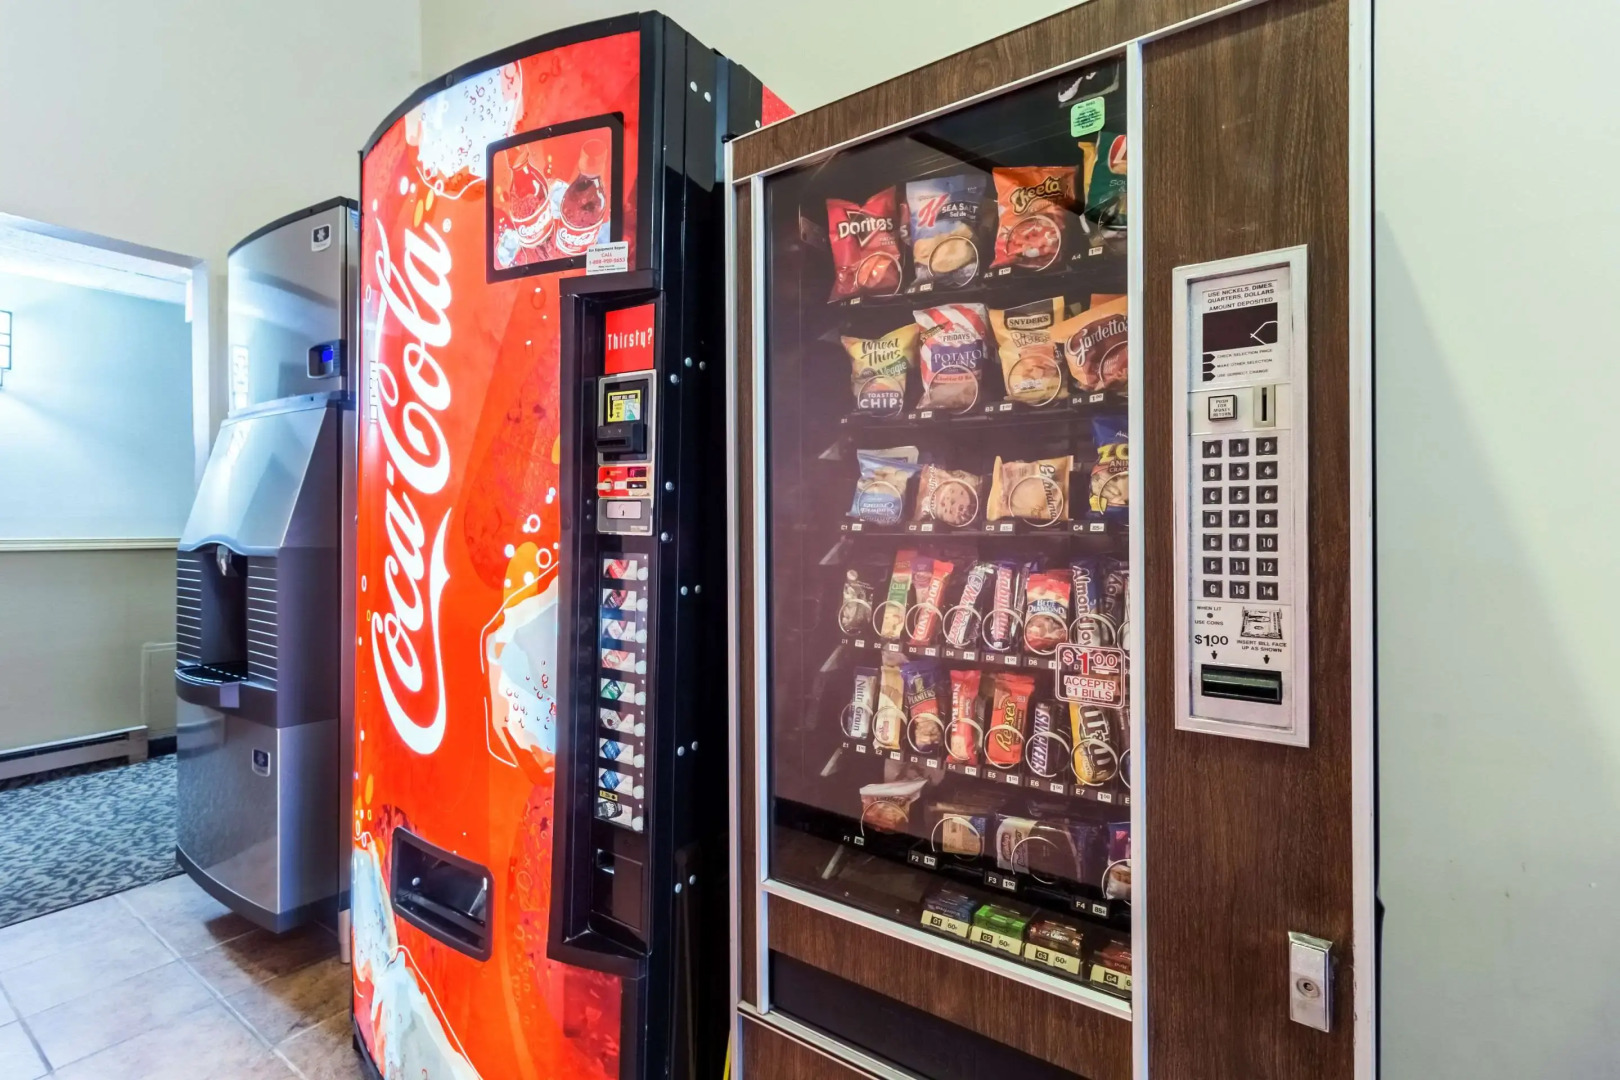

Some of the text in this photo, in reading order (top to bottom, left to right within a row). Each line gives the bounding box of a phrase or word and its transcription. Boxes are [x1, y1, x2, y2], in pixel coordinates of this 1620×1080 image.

[1010, 176, 1062, 215] Cheeto
[942, 203, 978, 214] SEA SALT
[838, 216, 894, 239] Doritos
[1244, 289, 1274, 298] DOLLARS
[1209, 297, 1273, 312] AMOUNT DEPOSITED
[608, 328, 653, 350] Thirsty?
[943, 332, 971, 342] FRIDAYS
[862, 338, 899, 353] Wheat
[861, 350, 901, 366] Thins
[934, 350, 982, 364] POTATO
[878, 362, 907, 377] Veggie
[1210, 445, 1215, 454] A
[1238, 444, 1241, 452] 1
[1264, 442, 1270, 451] 2
[1237, 467, 1242, 476] 3
[1264, 466, 1271, 475] 4
[371, 216, 453, 755] Coca-Cola
[1210, 491, 1215, 500] C
[1237, 491, 1242, 499] 5
[1264, 490, 1270, 499] 6
[1210, 515, 1215, 524] D
[1238, 515, 1243, 523] 7
[1264, 514, 1269, 523] 8
[1211, 538, 1216, 547] E
[1237, 538, 1242, 547] 9
[1262, 538, 1272, 548] 10
[1211, 561, 1216, 570] F
[1236, 562, 1245, 570] 11
[1263, 562, 1272, 571] 12
[1210, 584, 1216, 593] G
[1236, 585, 1245, 594] 13
[1263, 586, 1272, 596] 14
[1072, 566, 1095, 625] Almond
[1027, 605, 1065, 614] DIAMOND
[1065, 676, 1115, 690] ACCEPTS
[908, 689, 936, 704] PLANTERS
[1082, 689, 1113, 700] BILLS
[854, 706, 863, 731] Grain
